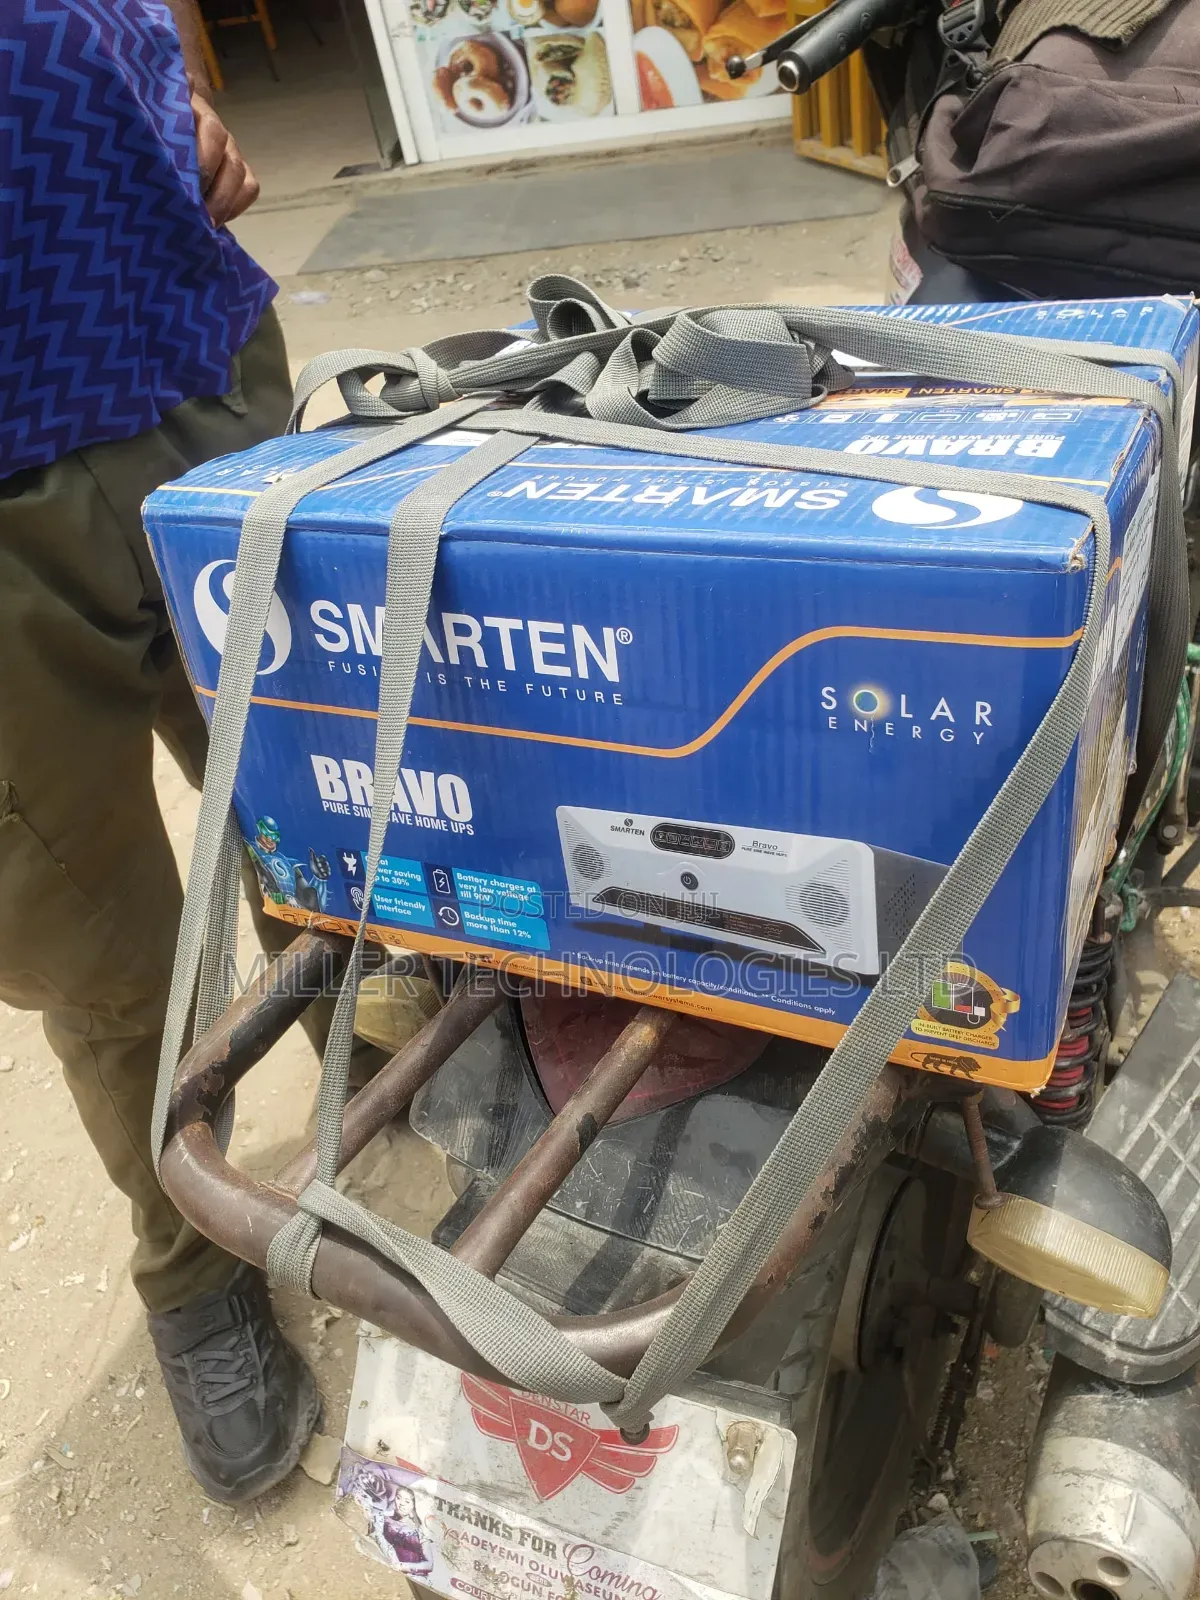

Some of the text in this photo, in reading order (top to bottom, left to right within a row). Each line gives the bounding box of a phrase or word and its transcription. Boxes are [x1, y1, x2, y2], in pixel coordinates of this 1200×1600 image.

[843, 439, 1064, 458] BRAVO
[328, 661, 623, 705] FUSI IS THE FUTURE
[821, 687, 992, 727] SOLAR
[828, 716, 985, 745] ENERGY
[322, 801, 475, 836] PURE SIN AVE HOME UPS
[610, 825, 645, 836] SMARTEN
[752, 840, 778, 850] Bravo
[392, 877, 410, 886] 30%
[394, 870, 422, 882] saving
[456, 873, 488, 888] Battery
[490, 878, 525, 893] charges
[459, 884, 530, 901] very low voltage
[460, 890, 491, 902] till 90V
[374, 894, 426, 912] User friendly
[376, 903, 412, 916] interface
[464, 911, 517, 928] Backup time
[466, 921, 532, 939] more than 12%
[662, 971, 687, 983] battery
[771, 995, 812, 1012] Conditions
[814, 1005, 836, 1016] apply
[924, 1029, 947, 1037] PREVENT
[963, 1037, 996, 1047] DISCHARGE
[942, 1027, 965, 1035] BATTERY
[966, 1031, 993, 1041] CHARGER
[528, 1419, 573, 1462] DS
[434, 1496, 514, 1540] THANKS
[518, 1528, 558, 1560] FOR
[460, 1531, 525, 1567] ADEYEMI
